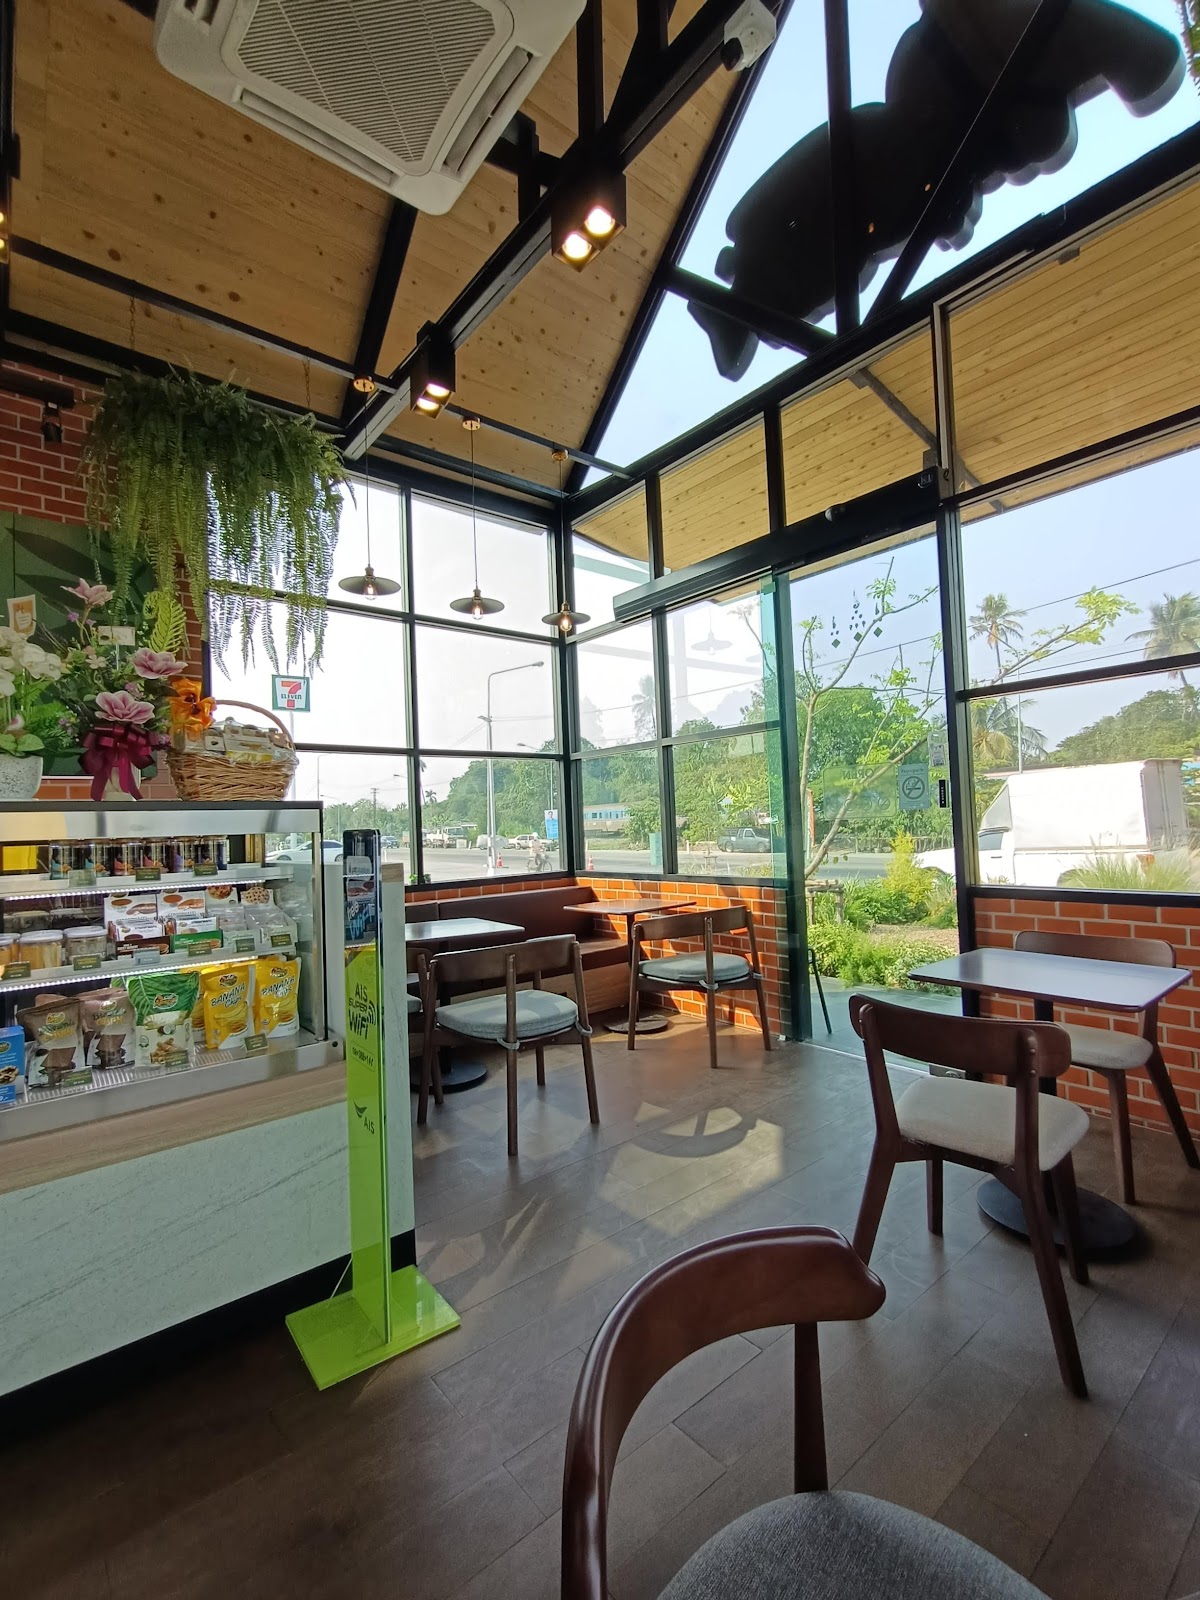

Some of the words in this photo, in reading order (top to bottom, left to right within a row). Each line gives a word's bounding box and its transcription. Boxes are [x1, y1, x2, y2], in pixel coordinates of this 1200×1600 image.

[281, 680, 302, 708] 7
[210, 982, 245, 1007] BANANA
[261, 975, 295, 996] BANANA
[355, 982, 368, 1003] AIS
[348, 997, 368, 1013] SUPER
[363, 1115, 375, 1135] AIS
